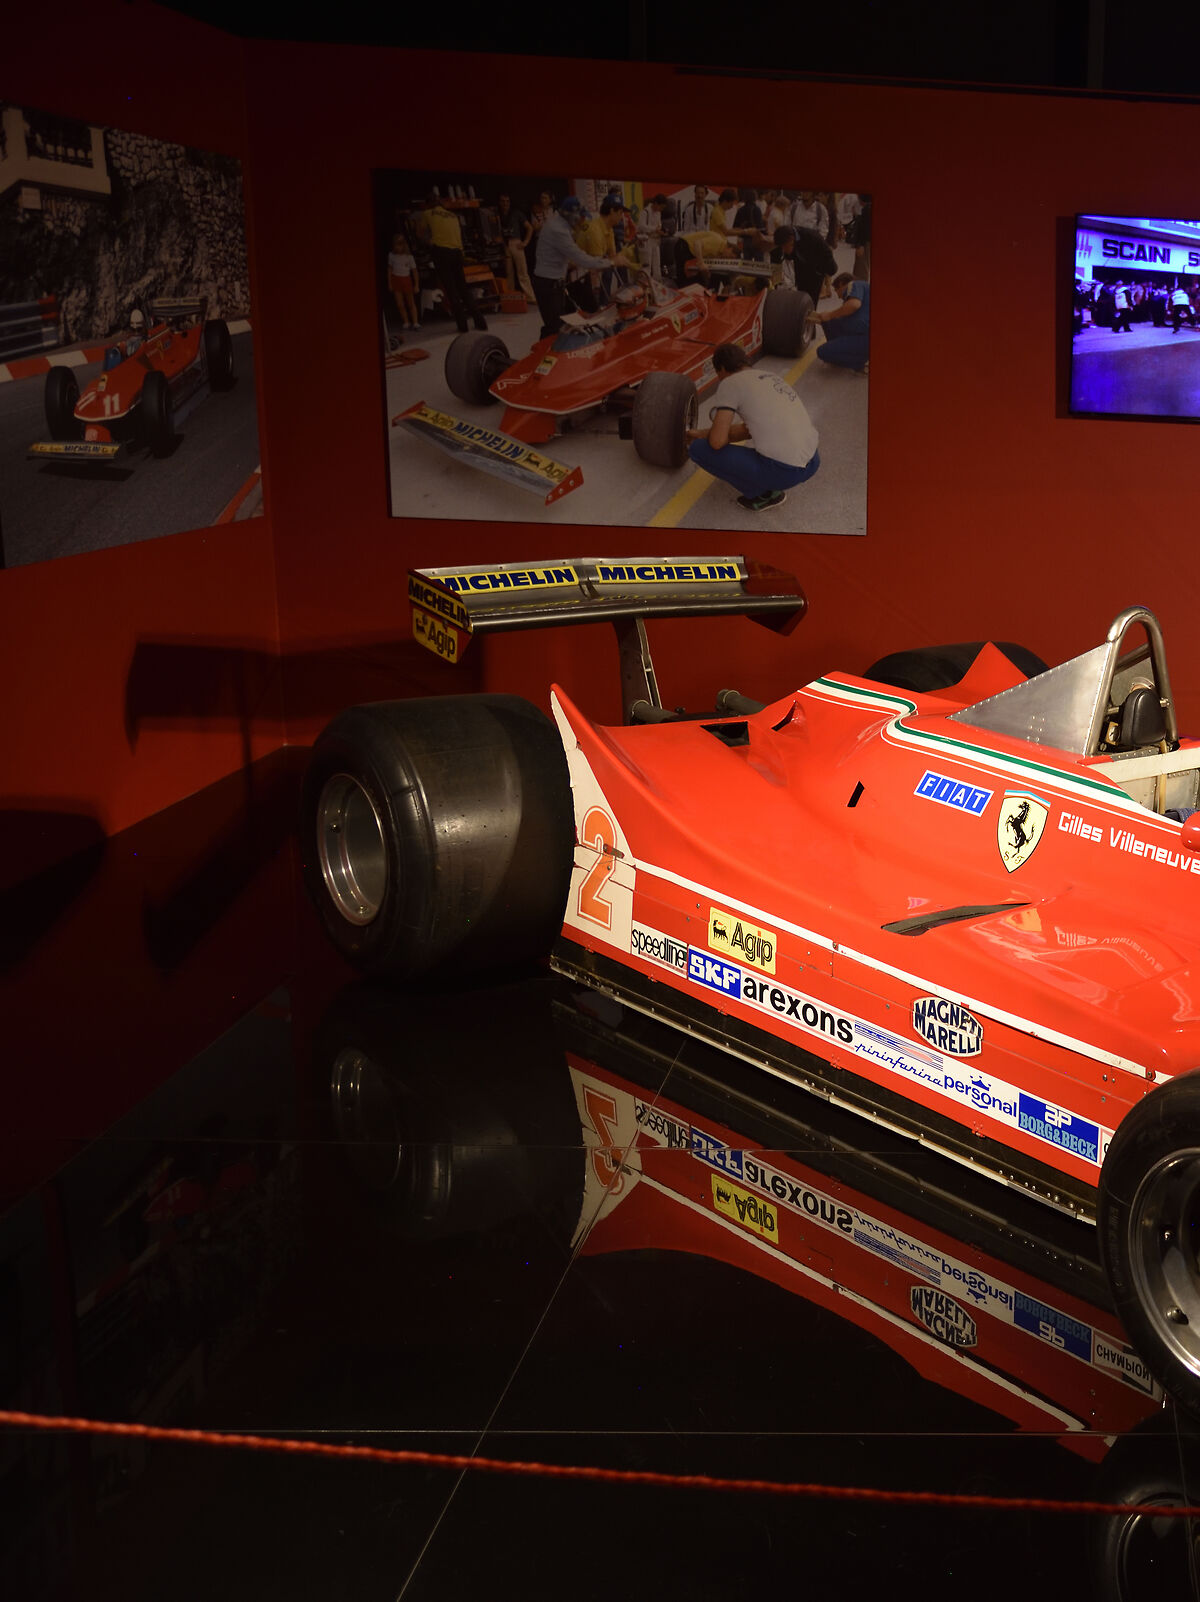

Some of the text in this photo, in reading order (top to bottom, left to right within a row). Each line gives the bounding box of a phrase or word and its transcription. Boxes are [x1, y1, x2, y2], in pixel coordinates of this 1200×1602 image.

[1102, 239, 1171, 264] SCAINI
[102, 392, 120, 416] 11
[453, 421, 525, 459] MICHELIN
[432, 566, 576, 592] MICHELIN
[600, 565, 737, 581] MICHELIN
[408, 577, 470, 629] MICHELIN
[428, 621, 455, 657] Agip
[920, 776, 987, 811] FIAT
[1057, 811, 1103, 843] Gilles
[576, 805, 618, 931] 2
[731, 922, 773, 966] Agip
[631, 927, 688, 969] speedline
[689, 954, 741, 991] SKF
[743, 976, 854, 1044] arexons
[854, 1043, 944, 1088] pininfarina
[943, 1074, 1017, 1118] personal
[913, 1012, 982, 1054] MARELLI
[914, 998, 983, 1041] MAGNETI
[1019, 1110, 1097, 1161] BORG&BECK
